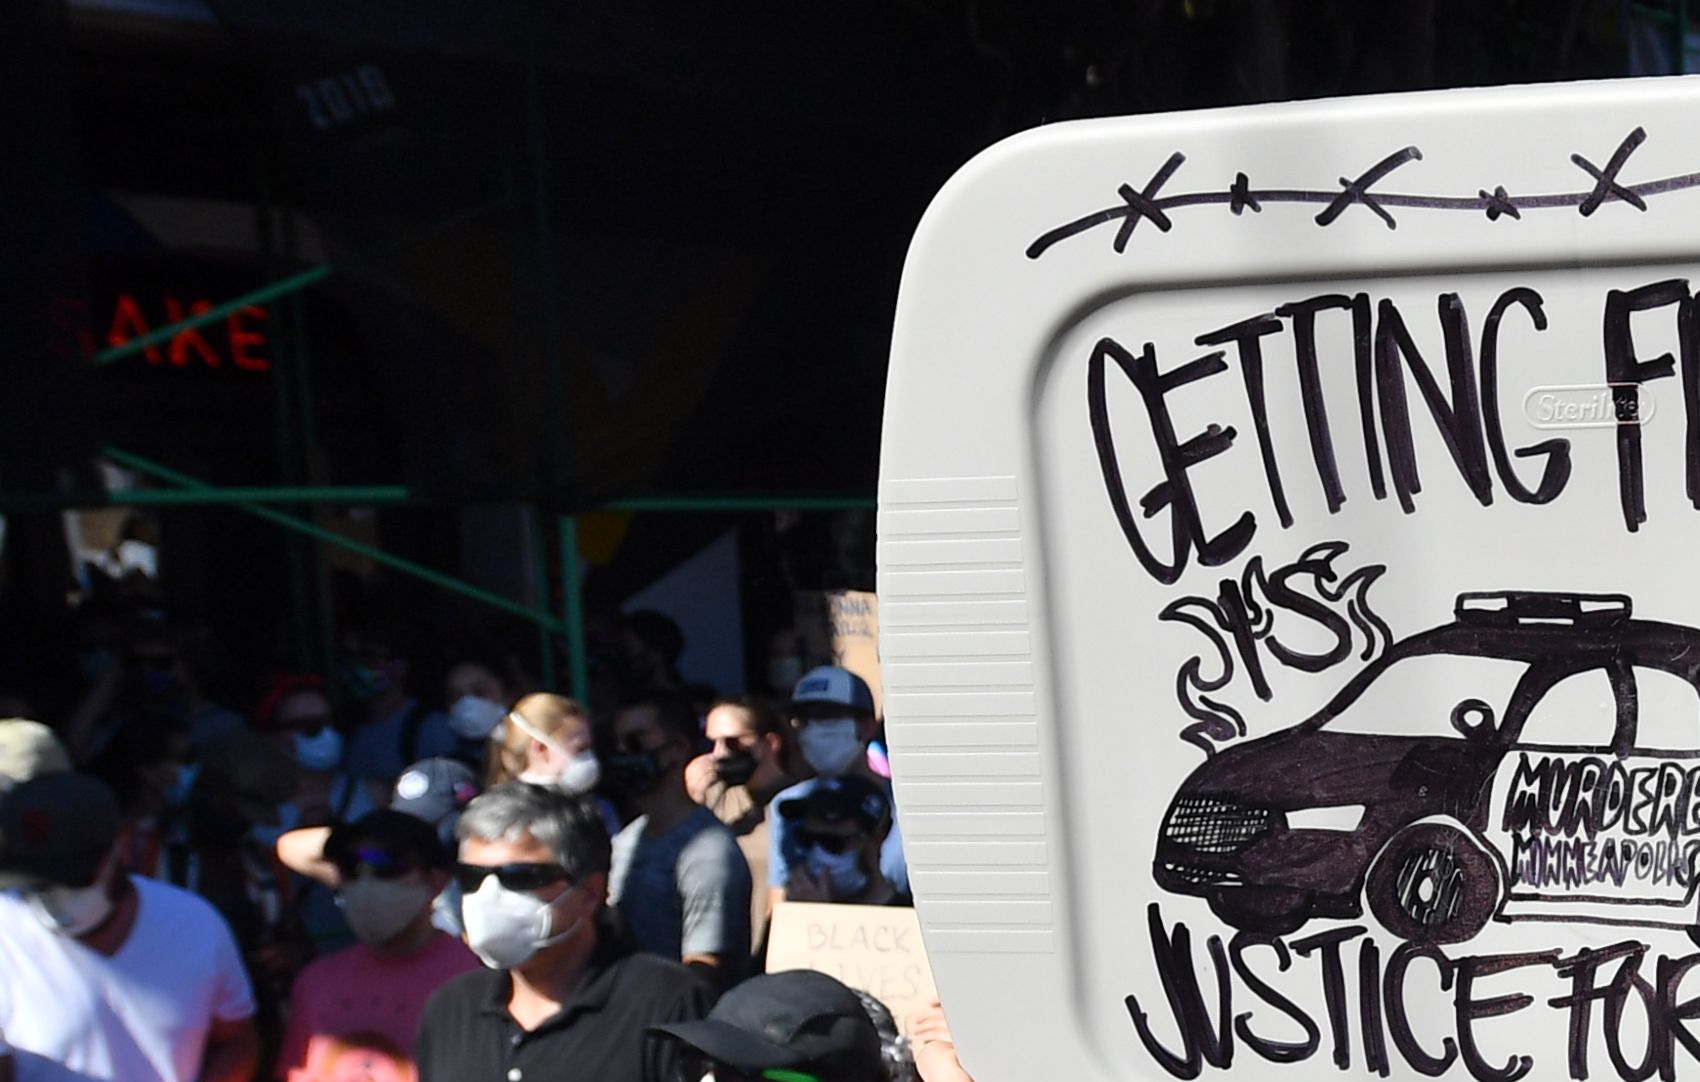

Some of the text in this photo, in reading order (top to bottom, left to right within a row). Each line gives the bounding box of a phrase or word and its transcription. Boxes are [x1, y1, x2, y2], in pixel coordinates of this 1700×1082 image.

[1088, 289, 1572, 583] GETTING
[807, 921, 912, 953] BLACK
[809, 960, 920, 1001] IVES
